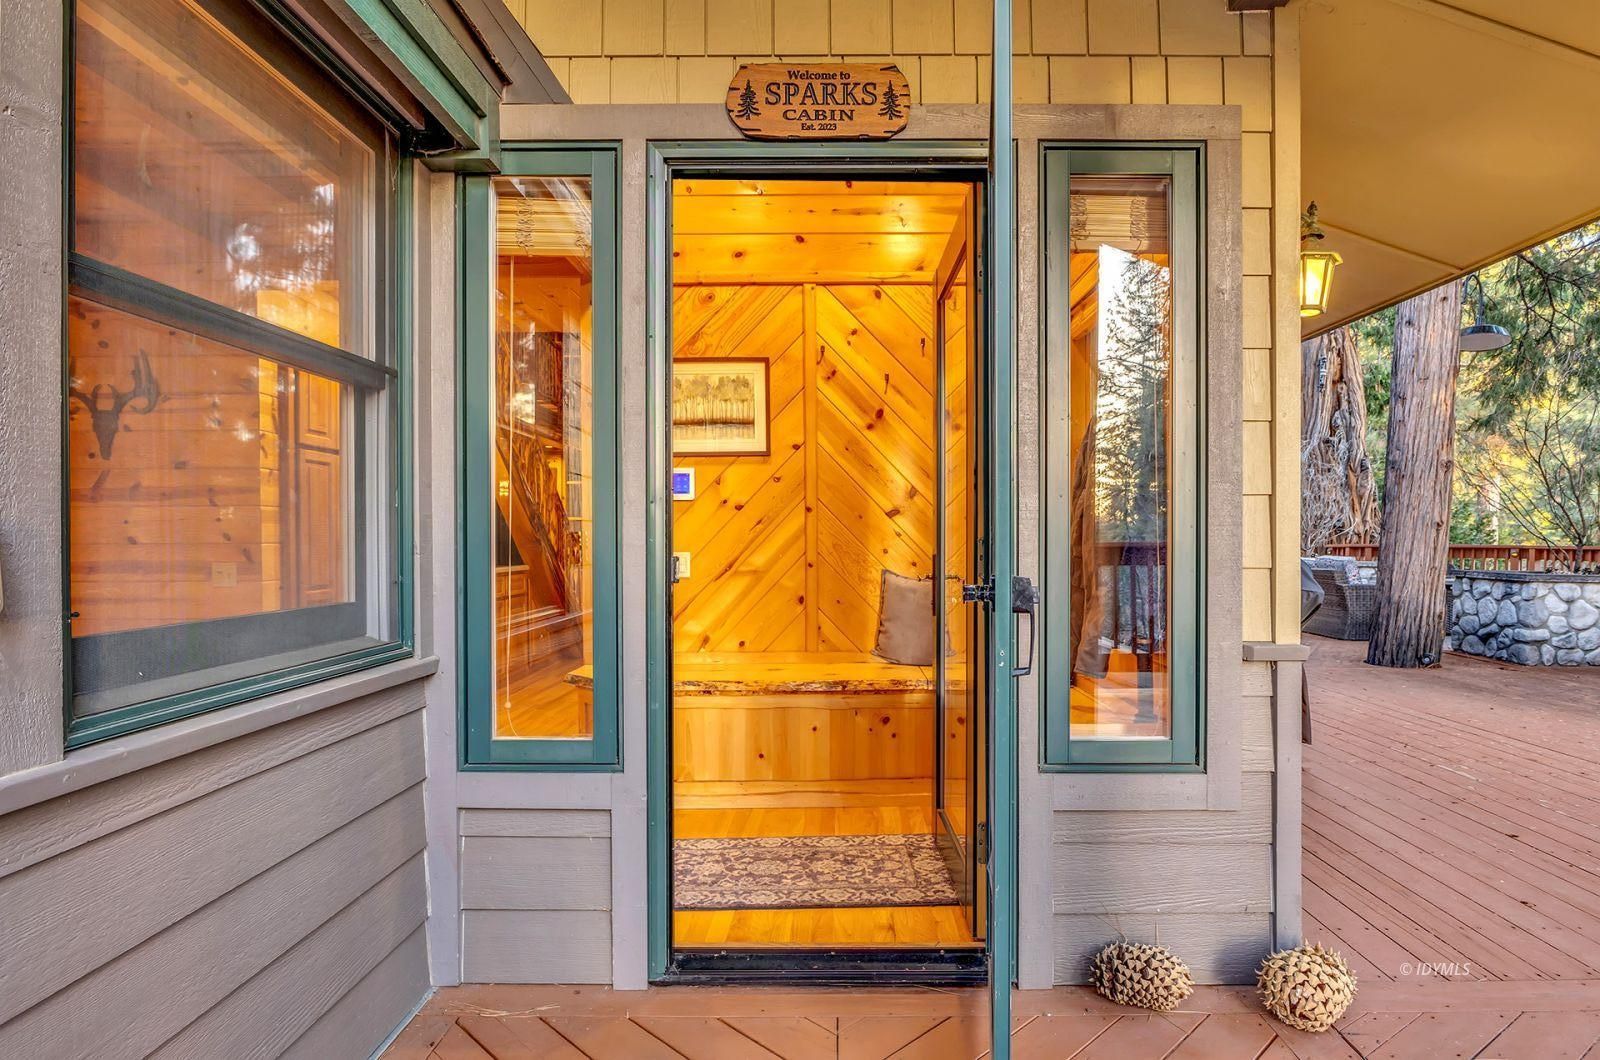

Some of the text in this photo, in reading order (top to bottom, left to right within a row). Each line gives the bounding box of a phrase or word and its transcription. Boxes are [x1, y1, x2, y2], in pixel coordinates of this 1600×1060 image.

[787, 70, 850, 80] Welcome to
[765, 82, 877, 106] SPARKS
[783, 109, 855, 121] CABIN
[801, 122, 837, 130] Est. 2023
